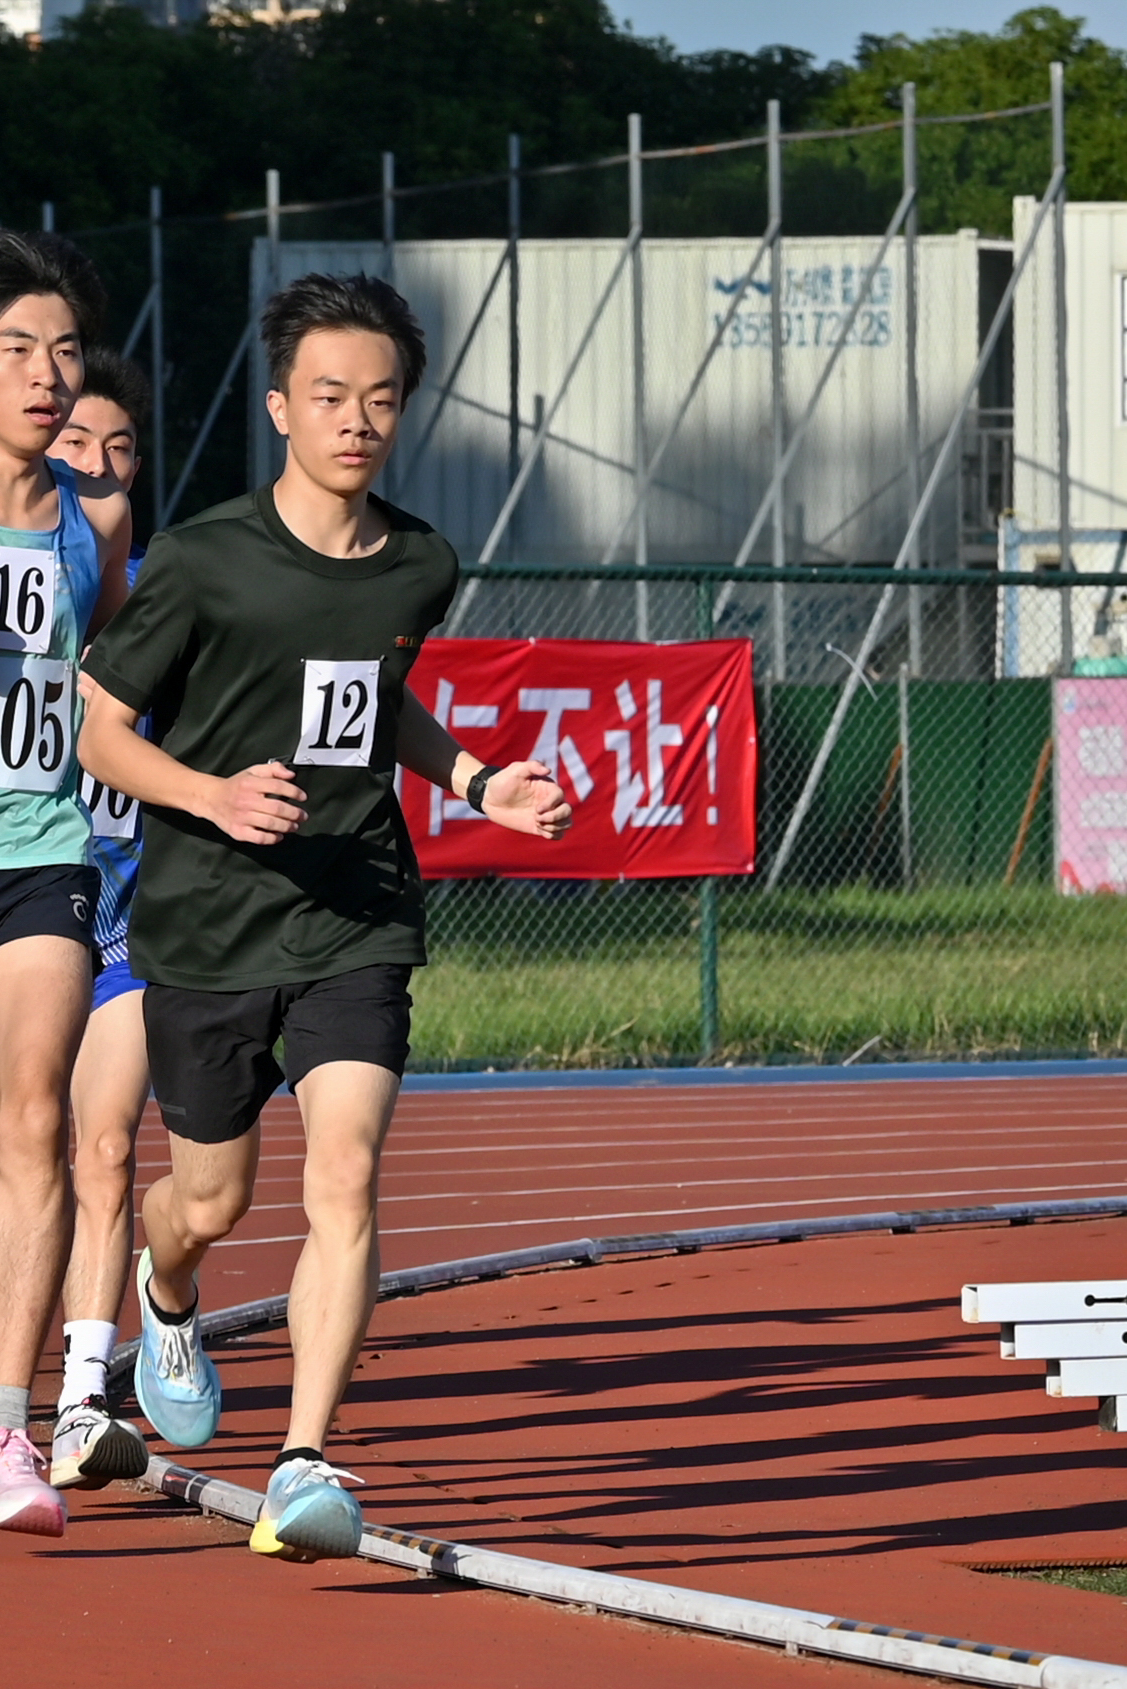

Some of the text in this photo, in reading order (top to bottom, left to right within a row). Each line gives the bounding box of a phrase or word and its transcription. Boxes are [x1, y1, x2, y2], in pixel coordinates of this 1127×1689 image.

[307, 679, 367, 750] 12
[393, 677, 718, 837] 仁不让！
